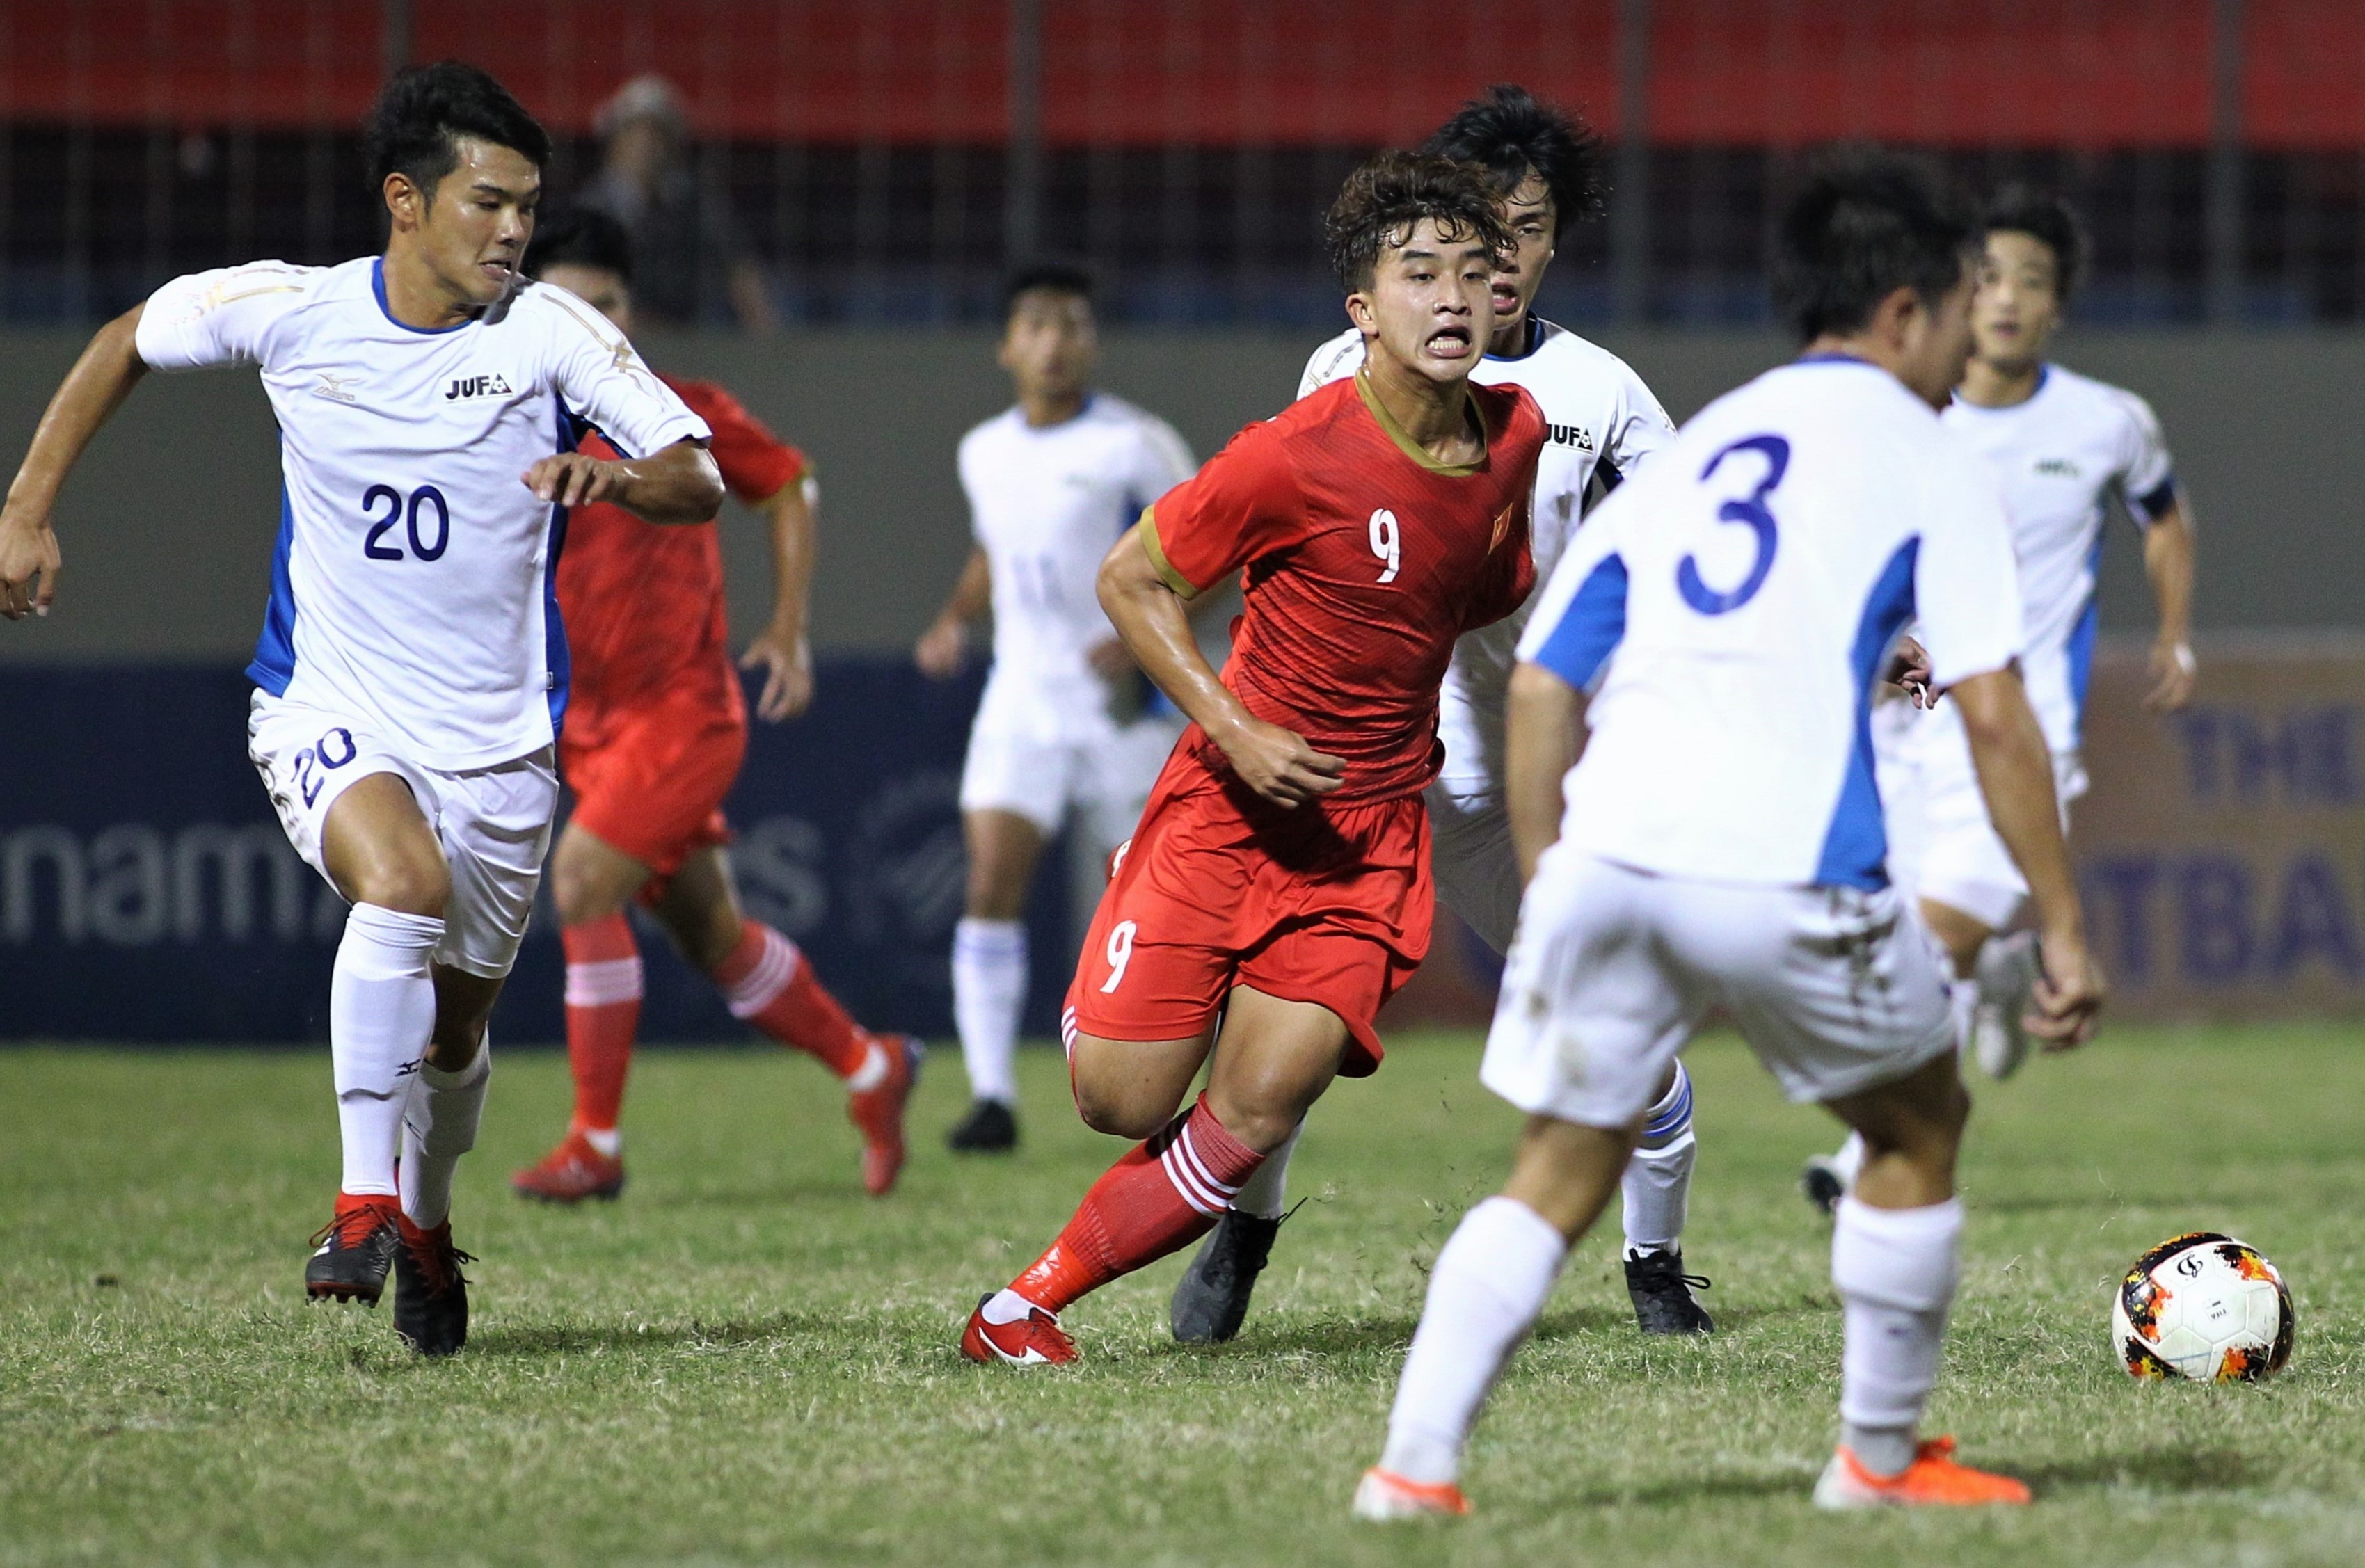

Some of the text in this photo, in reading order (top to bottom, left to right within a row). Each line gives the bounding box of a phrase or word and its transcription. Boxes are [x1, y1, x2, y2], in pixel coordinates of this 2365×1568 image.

[363, 483, 449, 561] 20
[1369, 508, 1400, 583] 9
[1675, 433, 1790, 615] 3
[290, 727, 356, 810] 20
[1099, 920, 1137, 993] 9
